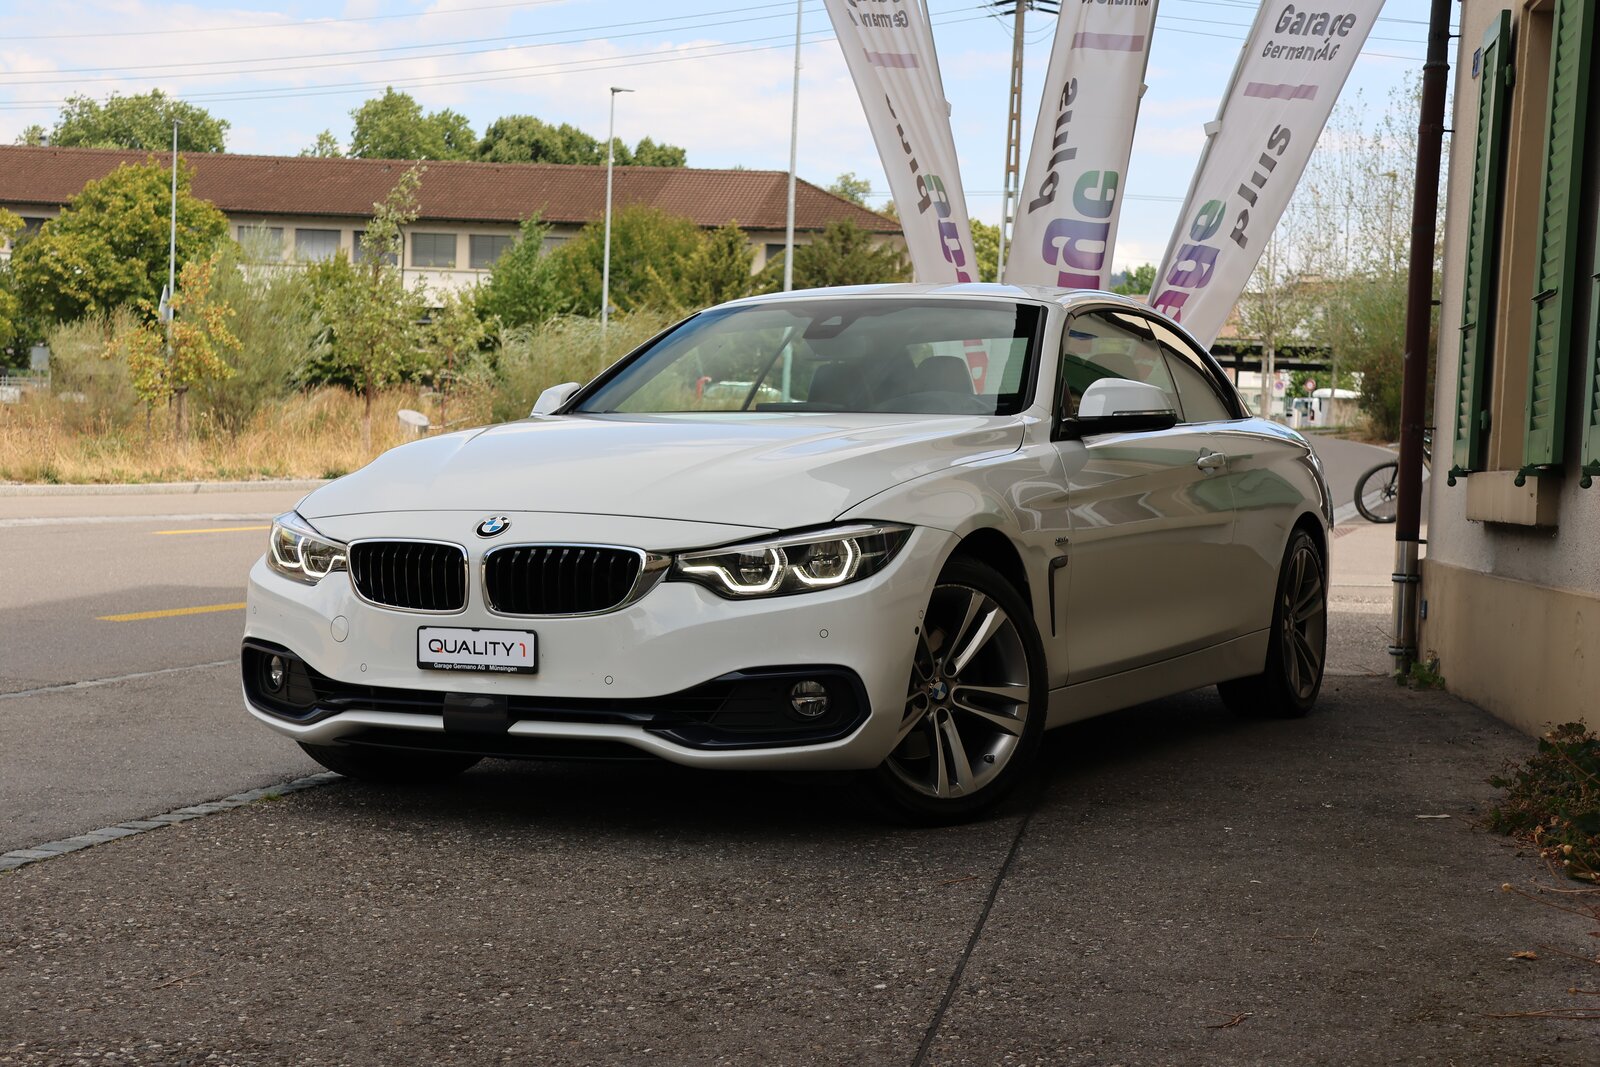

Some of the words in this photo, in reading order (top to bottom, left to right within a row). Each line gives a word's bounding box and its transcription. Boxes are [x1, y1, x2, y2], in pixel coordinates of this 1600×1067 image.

[428, 638, 515, 657] QUALITY
[519, 642, 526, 658] 1
[433, 662, 453, 670] Garage
[489, 665, 518, 673] Münsingen
